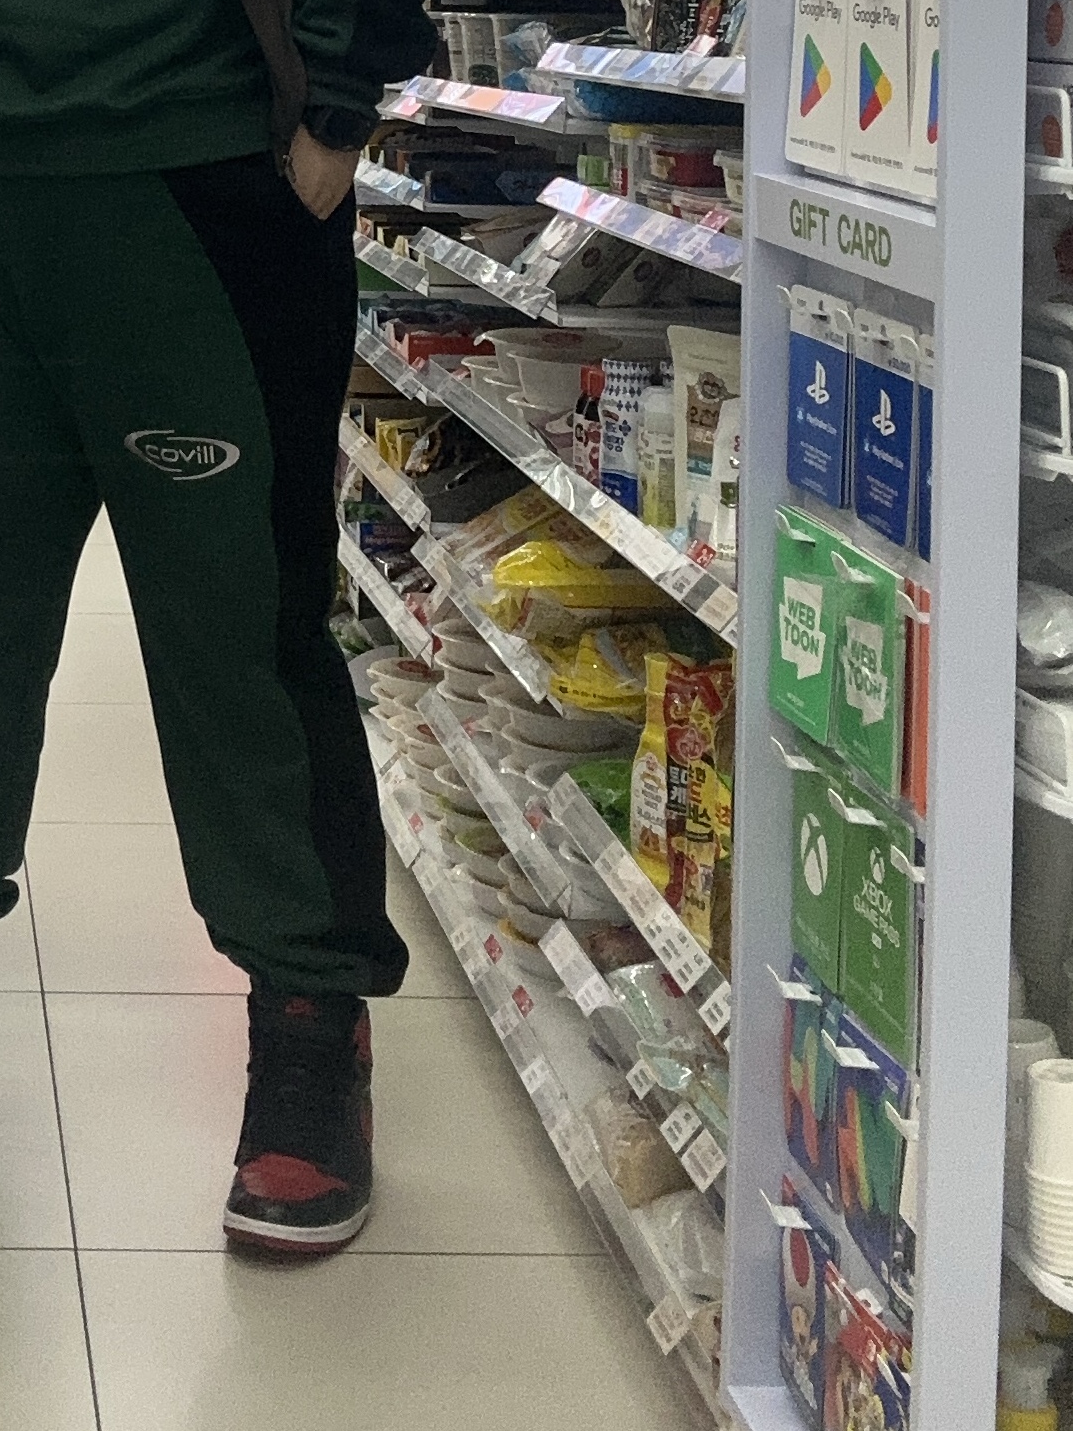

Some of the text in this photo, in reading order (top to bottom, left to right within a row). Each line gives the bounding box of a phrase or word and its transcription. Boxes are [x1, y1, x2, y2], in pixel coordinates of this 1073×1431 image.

[825, 2, 842, 24] Play
[853, 2, 882, 29] Google
[882, 6, 901, 31] Play
[789, 198, 892, 268] GIFT CARD
[145, 444, 215, 464] covill
[787, 596, 816, 631] WEB
[783, 616, 820, 657] TOON
[862, 876, 893, 922] XBOX
